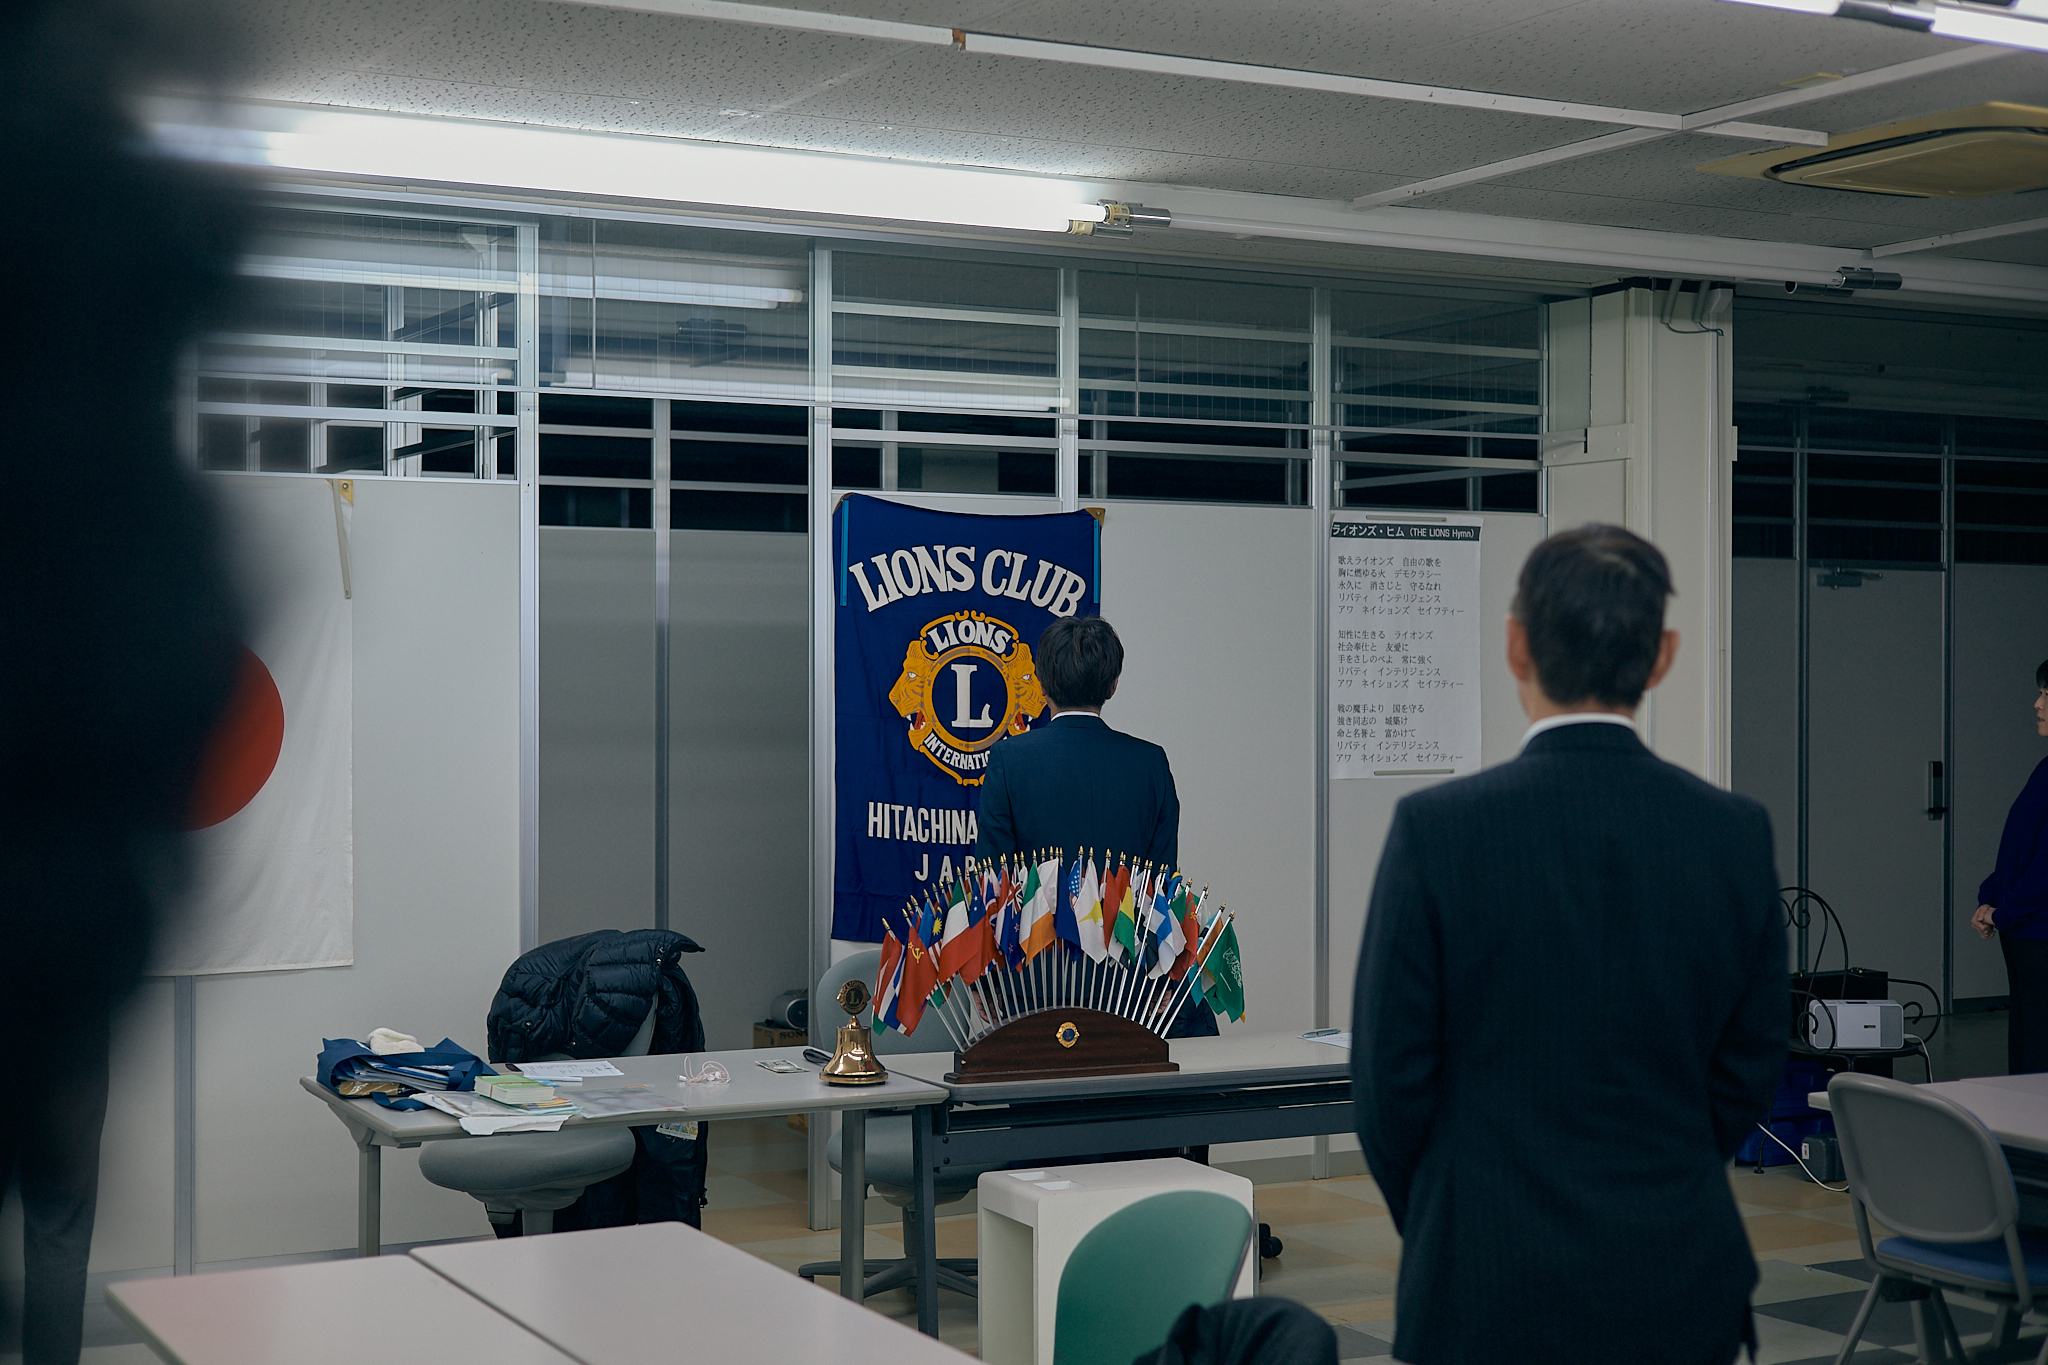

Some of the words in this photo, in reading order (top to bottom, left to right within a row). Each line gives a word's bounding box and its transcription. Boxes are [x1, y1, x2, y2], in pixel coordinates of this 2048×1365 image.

[1332, 525, 1405, 537] ライオンズ・ヒム
[1429, 528, 1450, 538] LIONS
[1337, 556, 1394, 566] 歌えライオンズ
[1402, 557, 1442, 567] 自由の歌を
[1394, 569, 1442, 579] デモクラシー
[848, 544, 976, 613] LIONS
[981, 548, 1087, 618] CLUB
[1337, 580, 1362, 590] 永久に
[1409, 581, 1442, 591] 守るなれ
[1378, 594, 1441, 603] インテリジェンス
[1338, 605, 1354, 614] アワ
[1362, 605, 1410, 615] ネイションズ
[1417, 606, 1465, 616] セイフティー
[927, 620, 1012, 653] LIONS
[1337, 630, 1386, 640] 知性に生きる
[1394, 630, 1433, 640] ライオンズ
[1337, 654, 1393, 664] 手をさしのべよ
[1377, 667, 1441, 676] インテリジェンス
[1337, 679, 1353, 688] アワ
[1361, 679, 1409, 688] ネイションズ
[1417, 679, 1463, 689] セイフティー
[951, 664, 994, 728] L
[1392, 704, 1425, 713] 国を守る
[1377, 741, 1440, 750] インテリジェンス
[1336, 753, 1352, 762] アワ
[1361, 753, 1408, 762] ネイションズ
[1416, 753, 1463, 762] セイフティー
